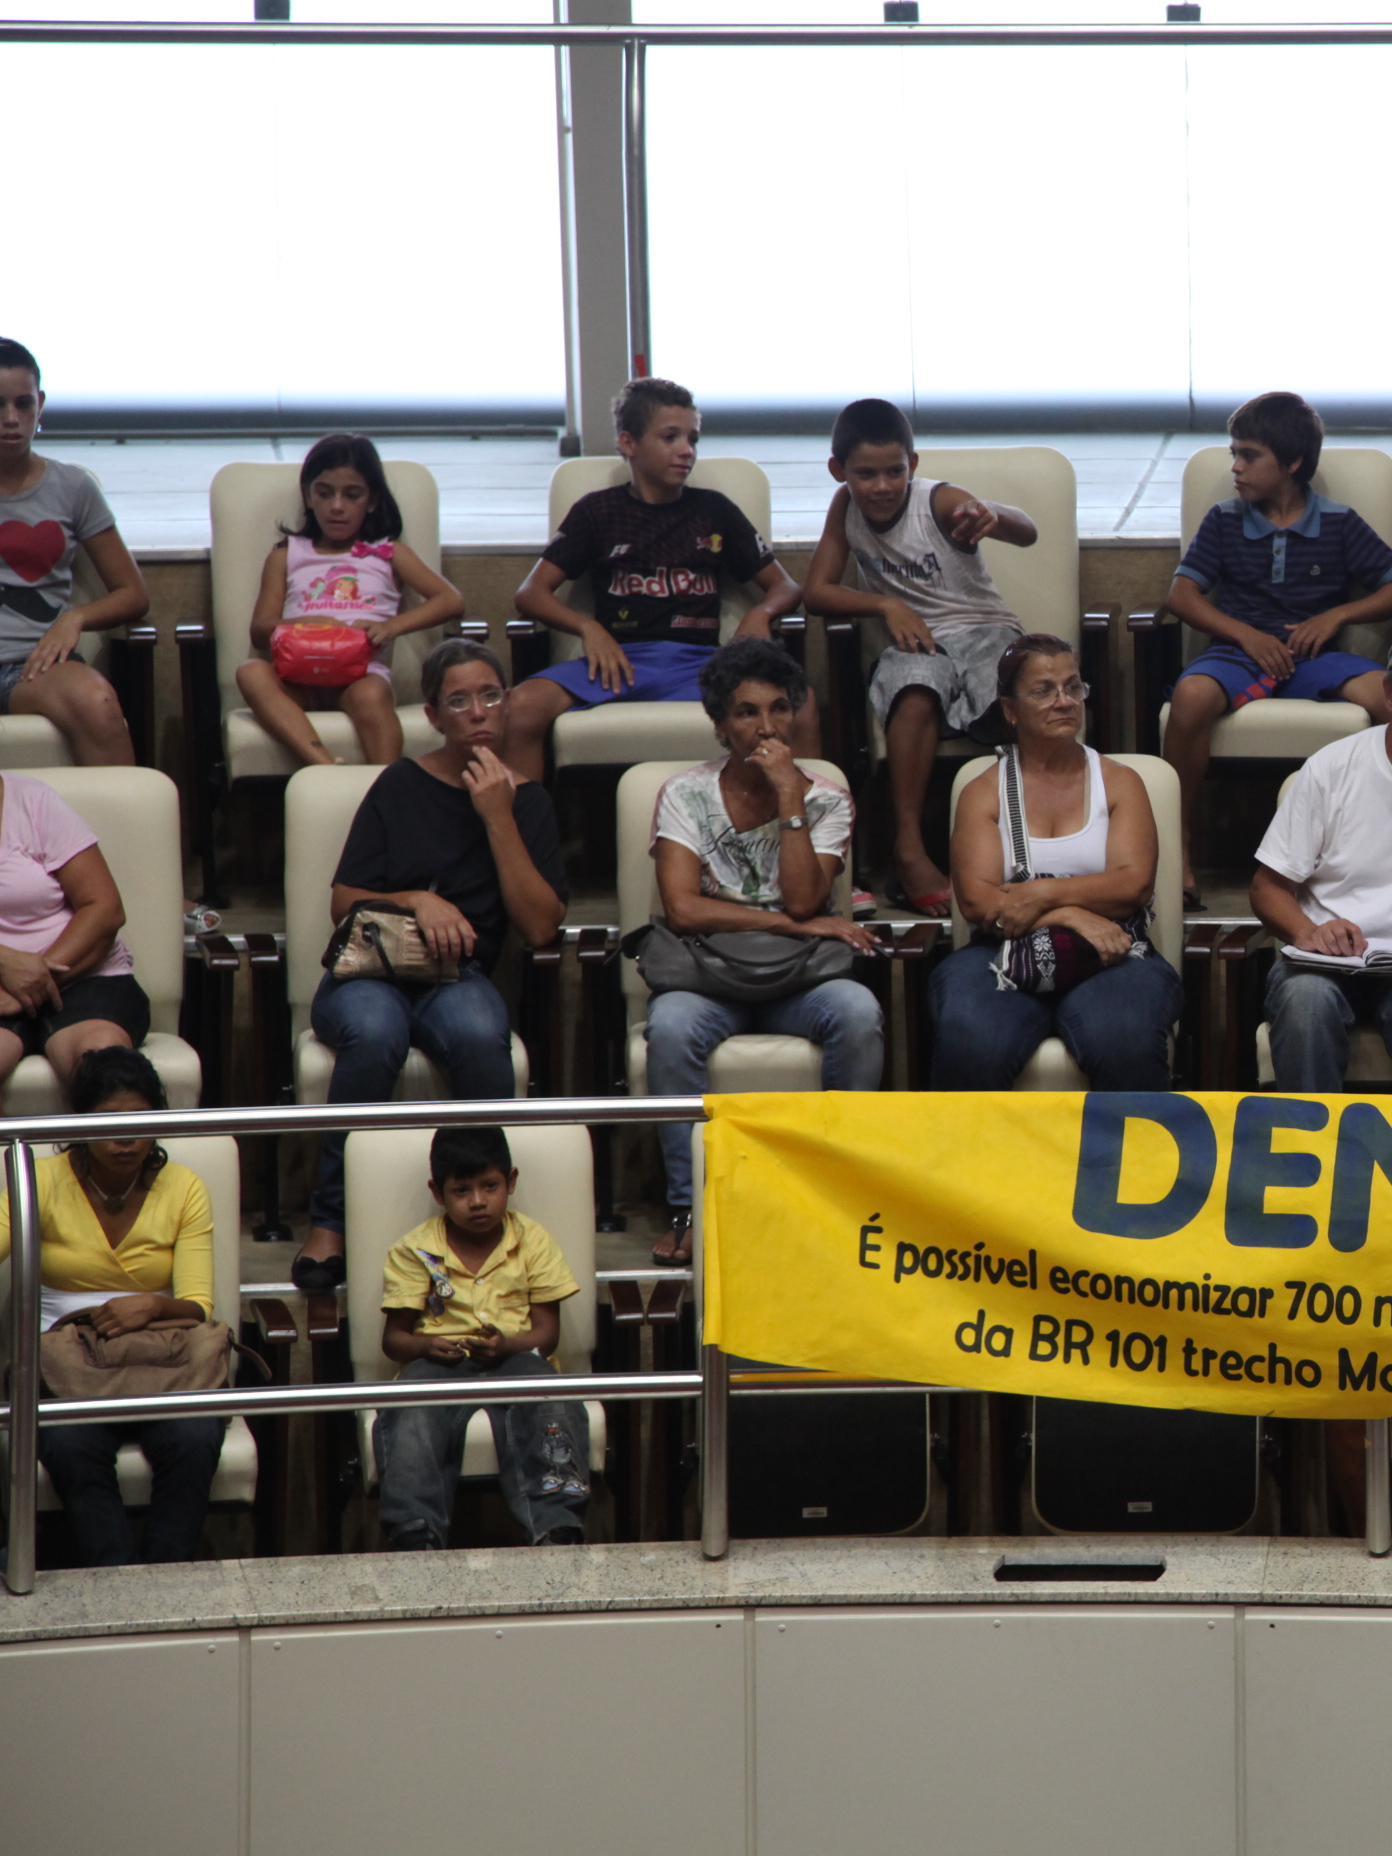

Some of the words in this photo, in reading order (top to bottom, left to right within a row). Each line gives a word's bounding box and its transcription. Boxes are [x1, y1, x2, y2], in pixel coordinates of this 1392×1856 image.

[608, 566, 669, 597] Red
[671, 567, 717, 596] Bull
[859, 1212, 884, 1270] É
[894, 1241, 1038, 1291] possível
[1048, 1265, 1275, 1319] economizar
[1284, 1280, 1362, 1326] 700
[955, 1308, 1014, 1358] da
[1028, 1313, 1095, 1366] BR
[1105, 1328, 1168, 1373] 101
[1181, 1337, 1323, 1389] trecho
